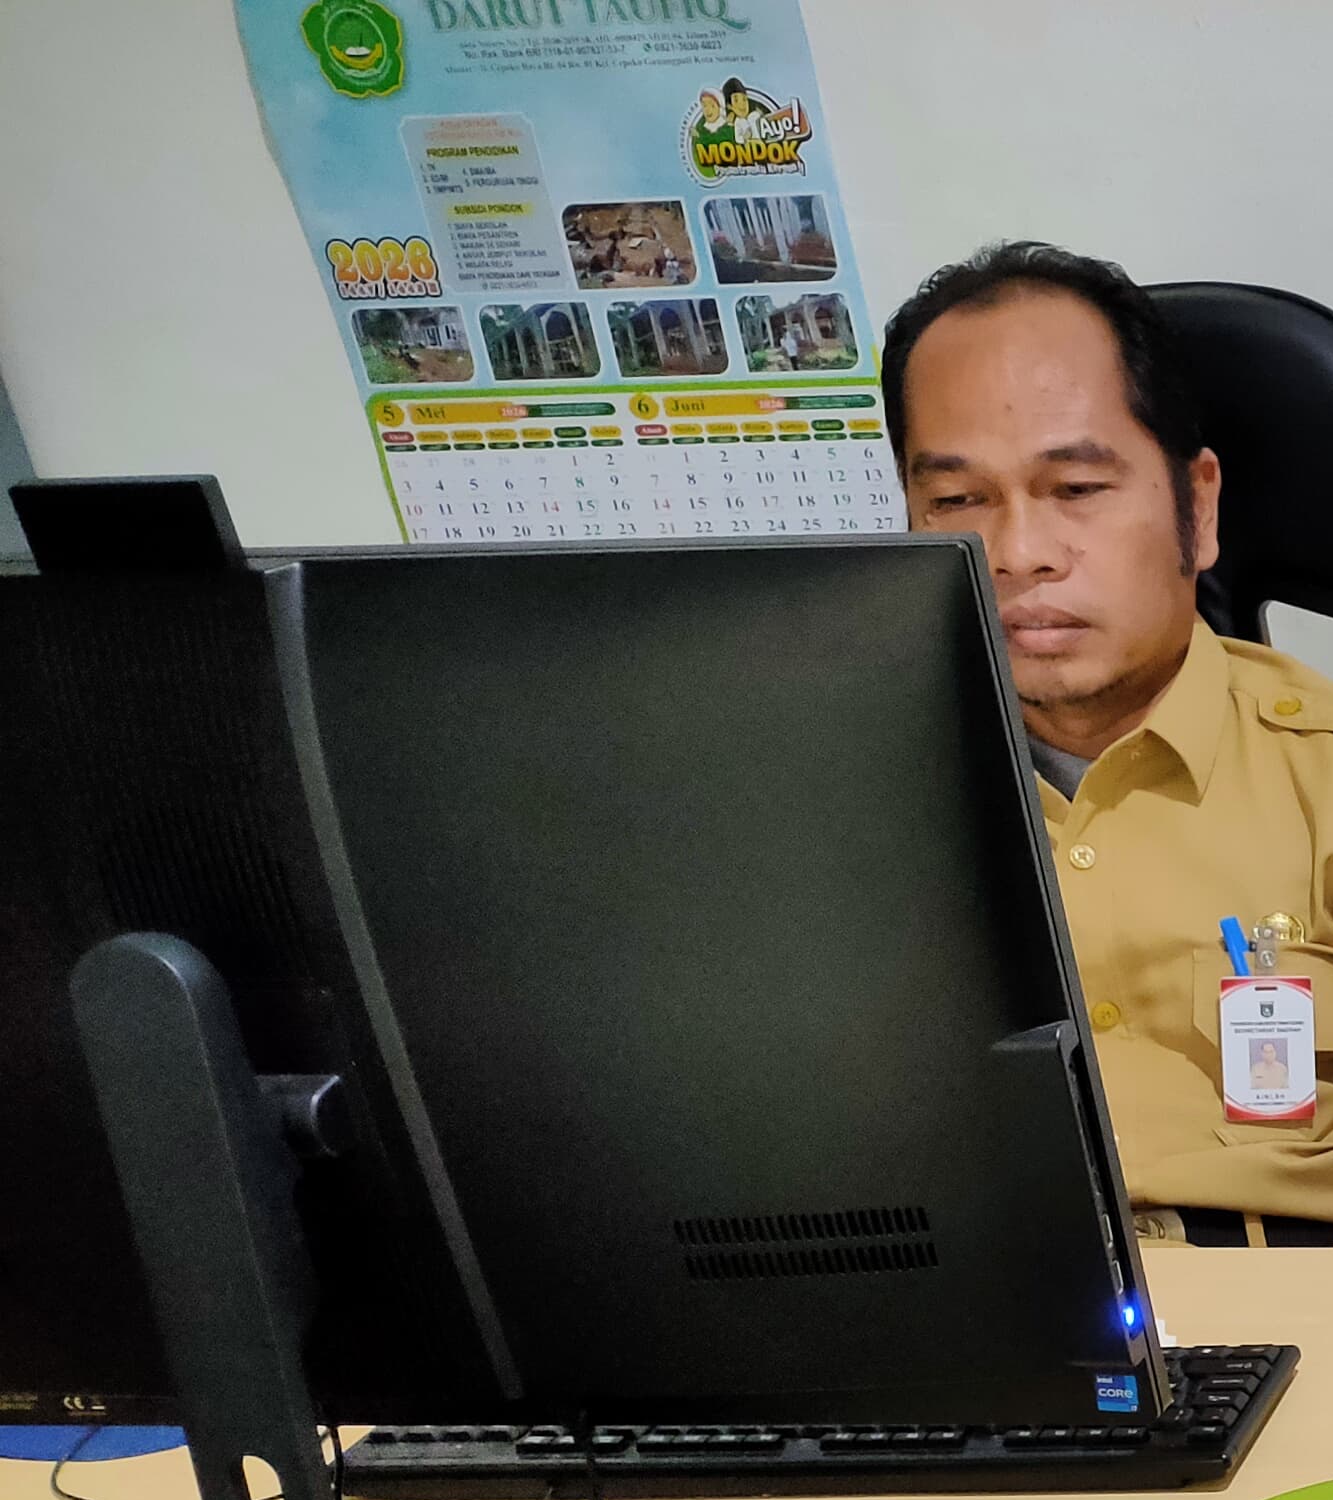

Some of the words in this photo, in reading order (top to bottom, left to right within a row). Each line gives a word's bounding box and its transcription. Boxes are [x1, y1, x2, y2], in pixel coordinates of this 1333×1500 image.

[759, 97, 800, 140] Ayo!
[696, 140, 799, 165] MONDOK
[327, 239, 436, 282] 2026
[383, 405, 395, 421] 5
[416, 407, 446, 419] Mei
[637, 399, 649, 412] 6
[671, 400, 705, 412] Juni
[756, 471, 775, 483] 10
[792, 471, 807, 482] 11
[827, 469, 846, 482] 12
[864, 469, 883, 481] 13
[404, 505, 423, 516] 10
[439, 504, 453, 515] 11
[473, 503, 491, 514] 12
[507, 502, 525, 513] 13
[542, 501, 560, 513] 14
[577, 500, 596, 512] 15
[612, 499, 630, 511] 16
[653, 498, 671, 510] 14
[689, 497, 707, 509] 15
[726, 496, 744, 508] 16
[761, 496, 779, 507] 17
[798, 495, 816, 507] 18
[833, 494, 851, 505] 19
[870, 493, 889, 505] 20
[412, 528, 429, 540] 17
[445, 527, 463, 539] 18
[478, 526, 495, 538] 19
[512, 526, 531, 537] 20
[548, 525, 565, 536] 21
[583, 524, 602, 536] 22
[618, 523, 637, 535] 23
[658, 522, 675, 534] 21
[695, 521, 713, 533] 22
[732, 520, 750, 532] 23
[767, 520, 786, 531] 24
[802, 518, 821, 530] 25
[839, 518, 858, 529] 26
[874, 517, 894, 529] 27
